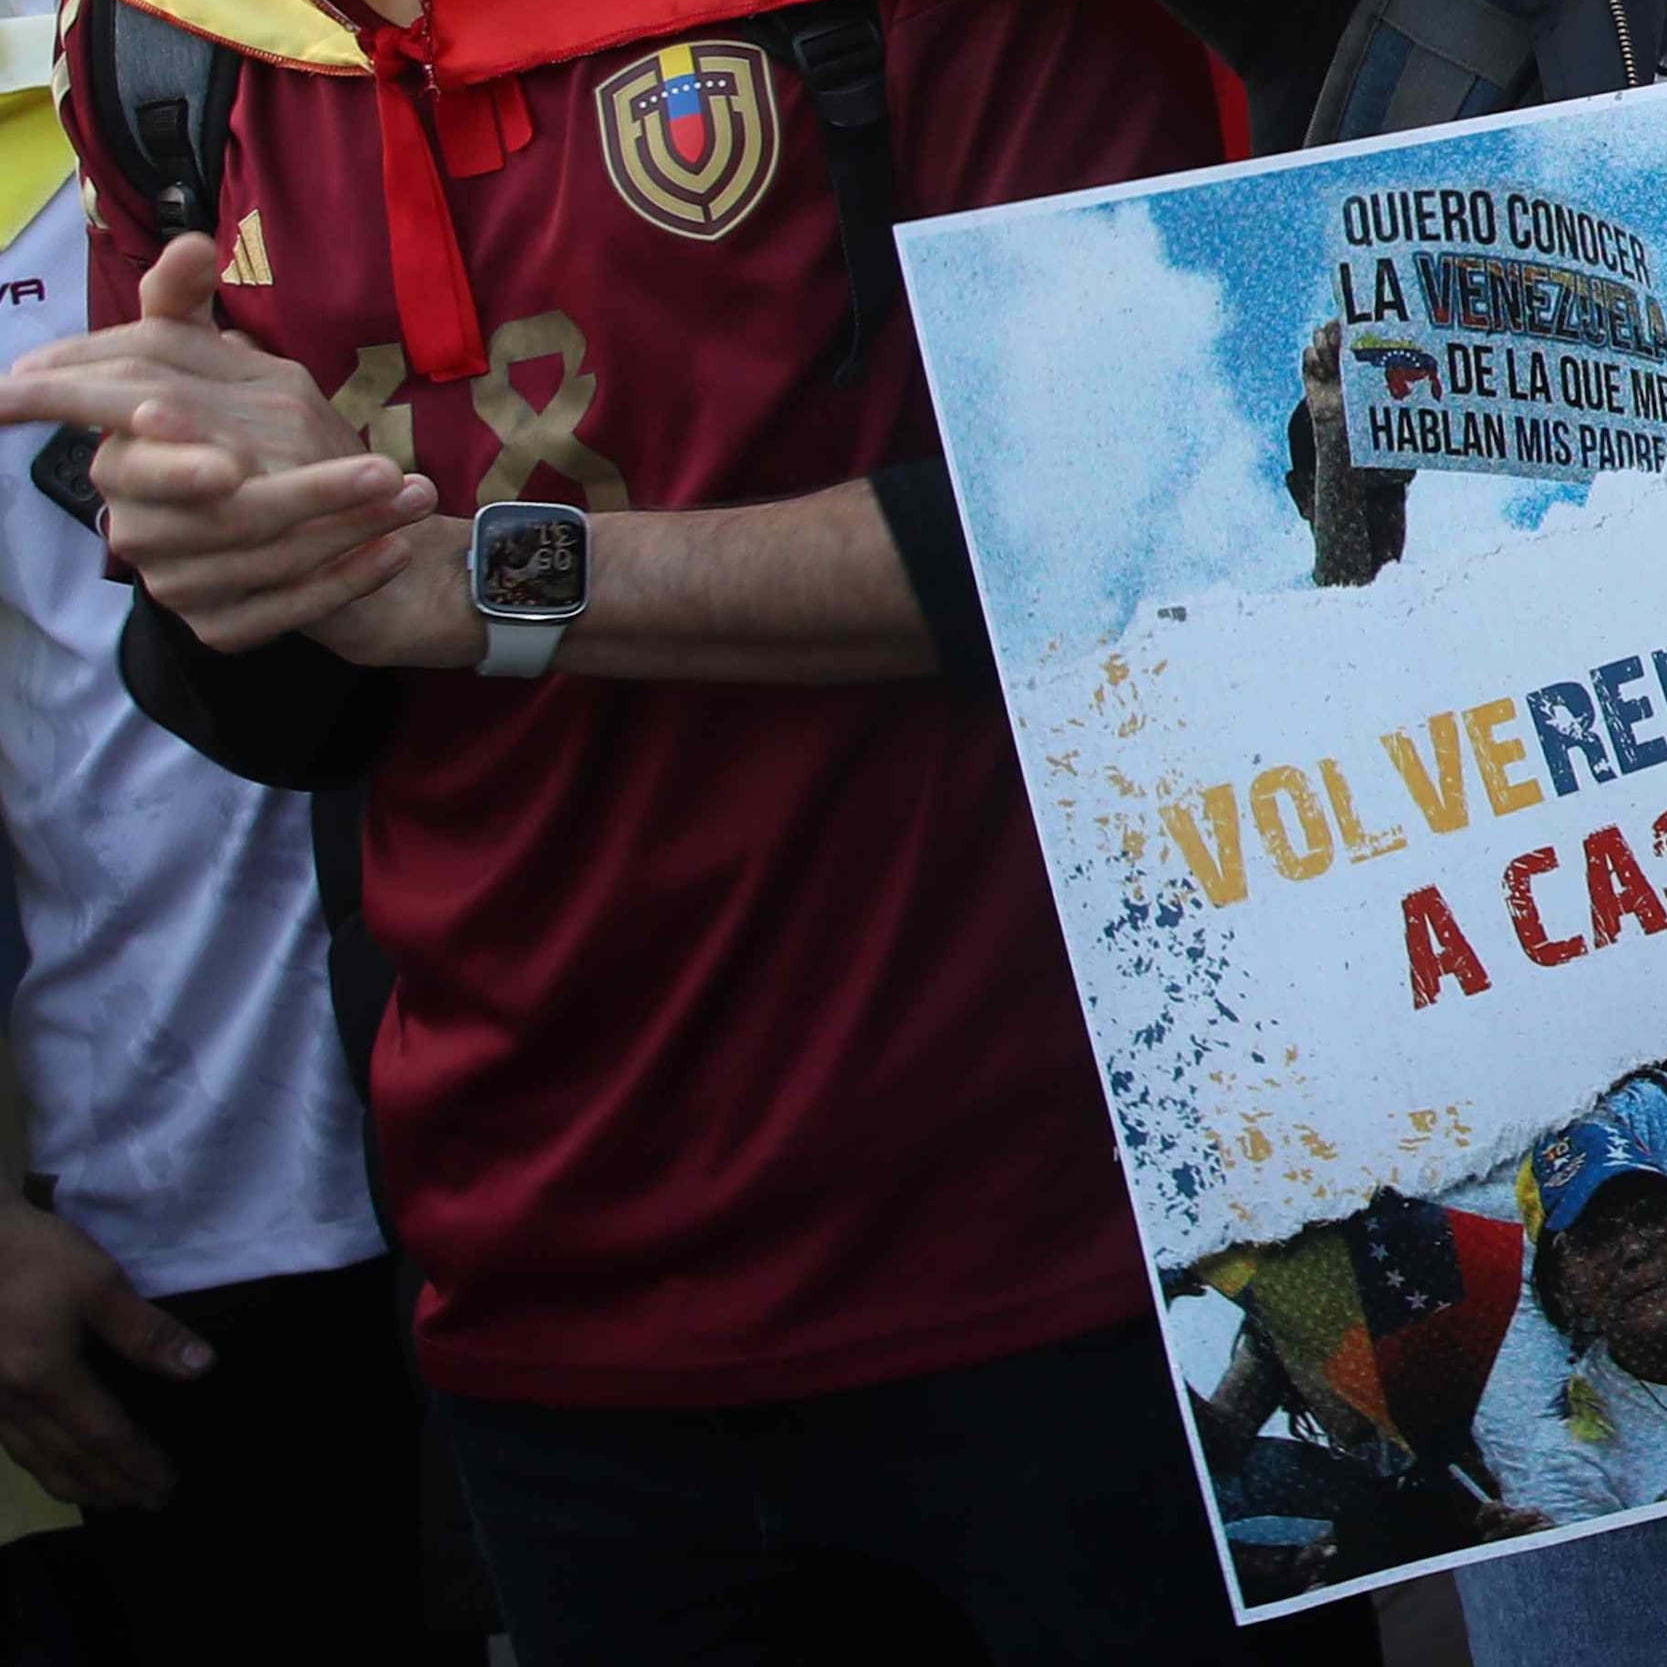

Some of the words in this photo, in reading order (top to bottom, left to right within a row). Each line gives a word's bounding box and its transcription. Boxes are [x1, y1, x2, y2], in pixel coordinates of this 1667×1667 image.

[1341, 189, 1498, 248] QUIERO
[1506, 193, 1653, 289] CONOCER
[1338, 257, 1410, 326] LA
[1446, 342, 1499, 398] DE
[1506, 347, 1553, 404] LA
[1559, 361, 1626, 414] QUE
[1368, 405, 1508, 461] HABLAN
[1514, 416, 1573, 466] MIS
[1400, 883, 1491, 1011] A
